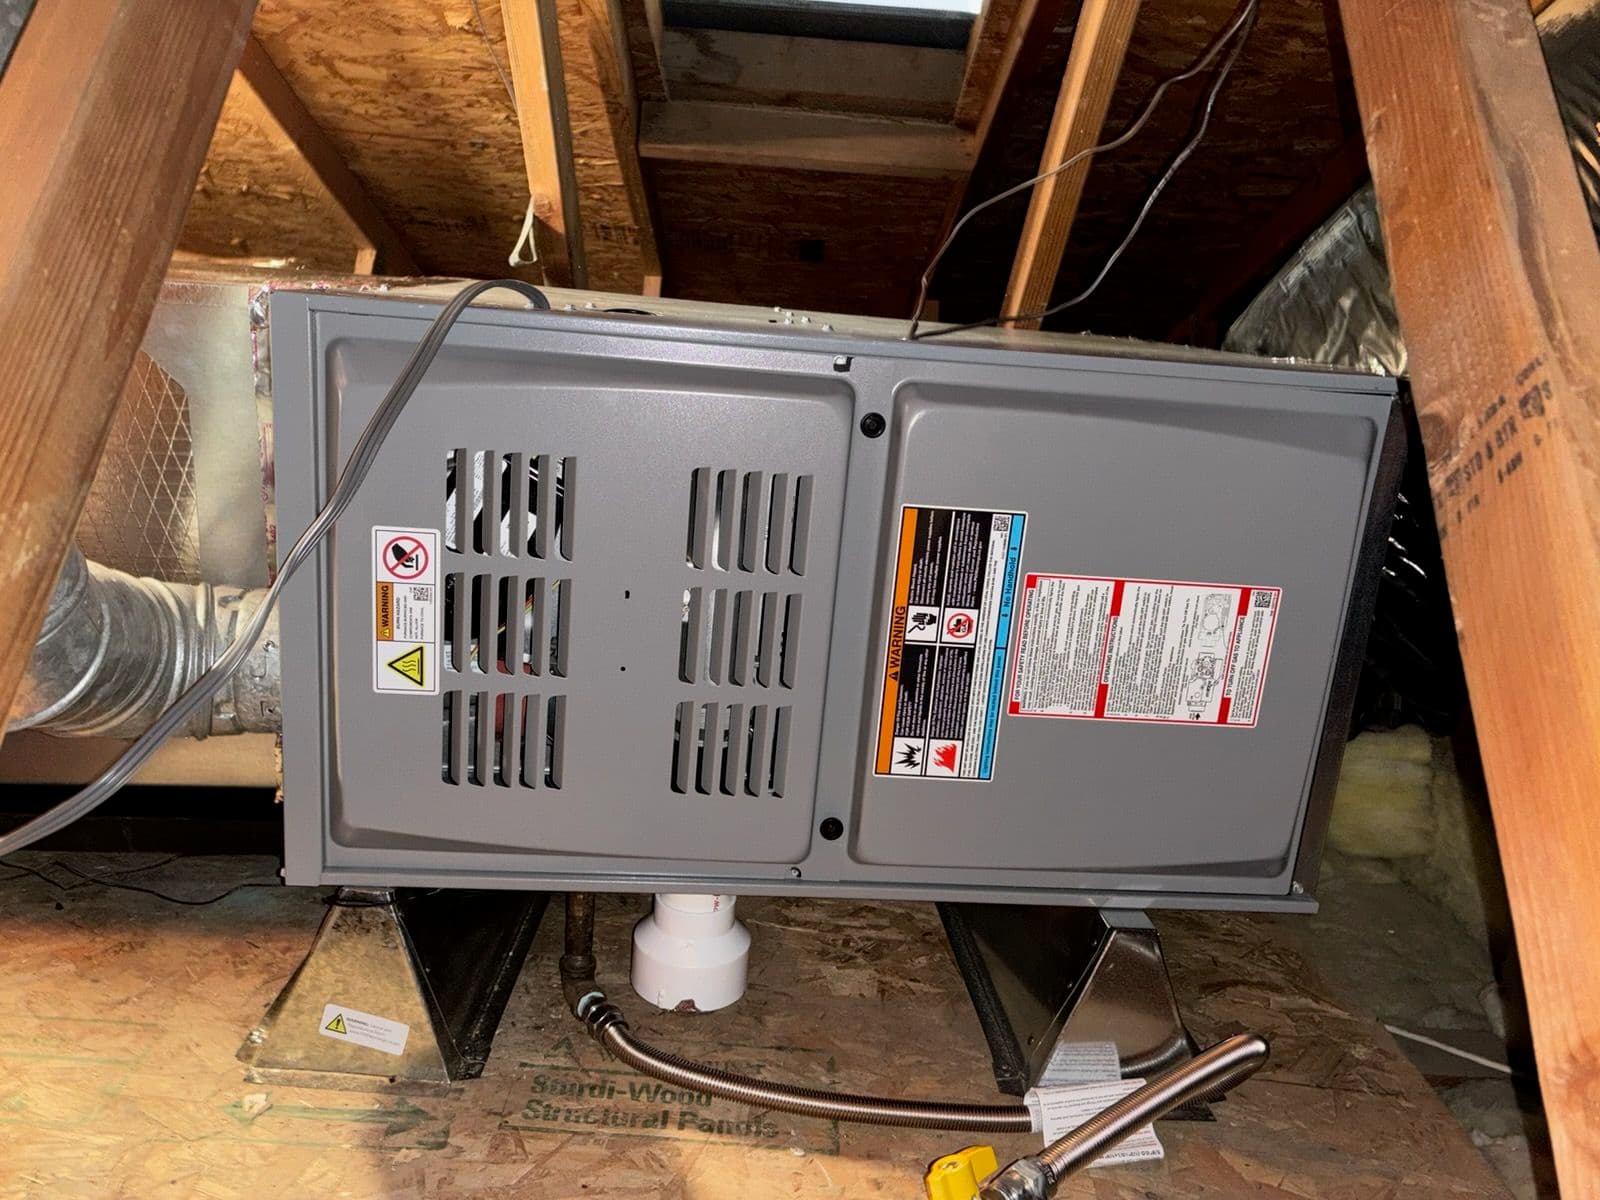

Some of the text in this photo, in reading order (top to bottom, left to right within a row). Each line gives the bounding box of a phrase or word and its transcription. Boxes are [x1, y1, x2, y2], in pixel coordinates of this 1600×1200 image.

[1002, 556, 1016, 607] No Handhold
[1025, 589, 1034, 618] OPERATING
[889, 606, 905, 668] WARNING
[1022, 618, 1030, 639] BEFORE
[1235, 616, 1245, 644] APPLIANCE
[1017, 655, 1025, 673] SAFETY
[1103, 616, 1118, 682] OPERATING INSTRUCTIONS
[520, 1098, 669, 1130] Structural
